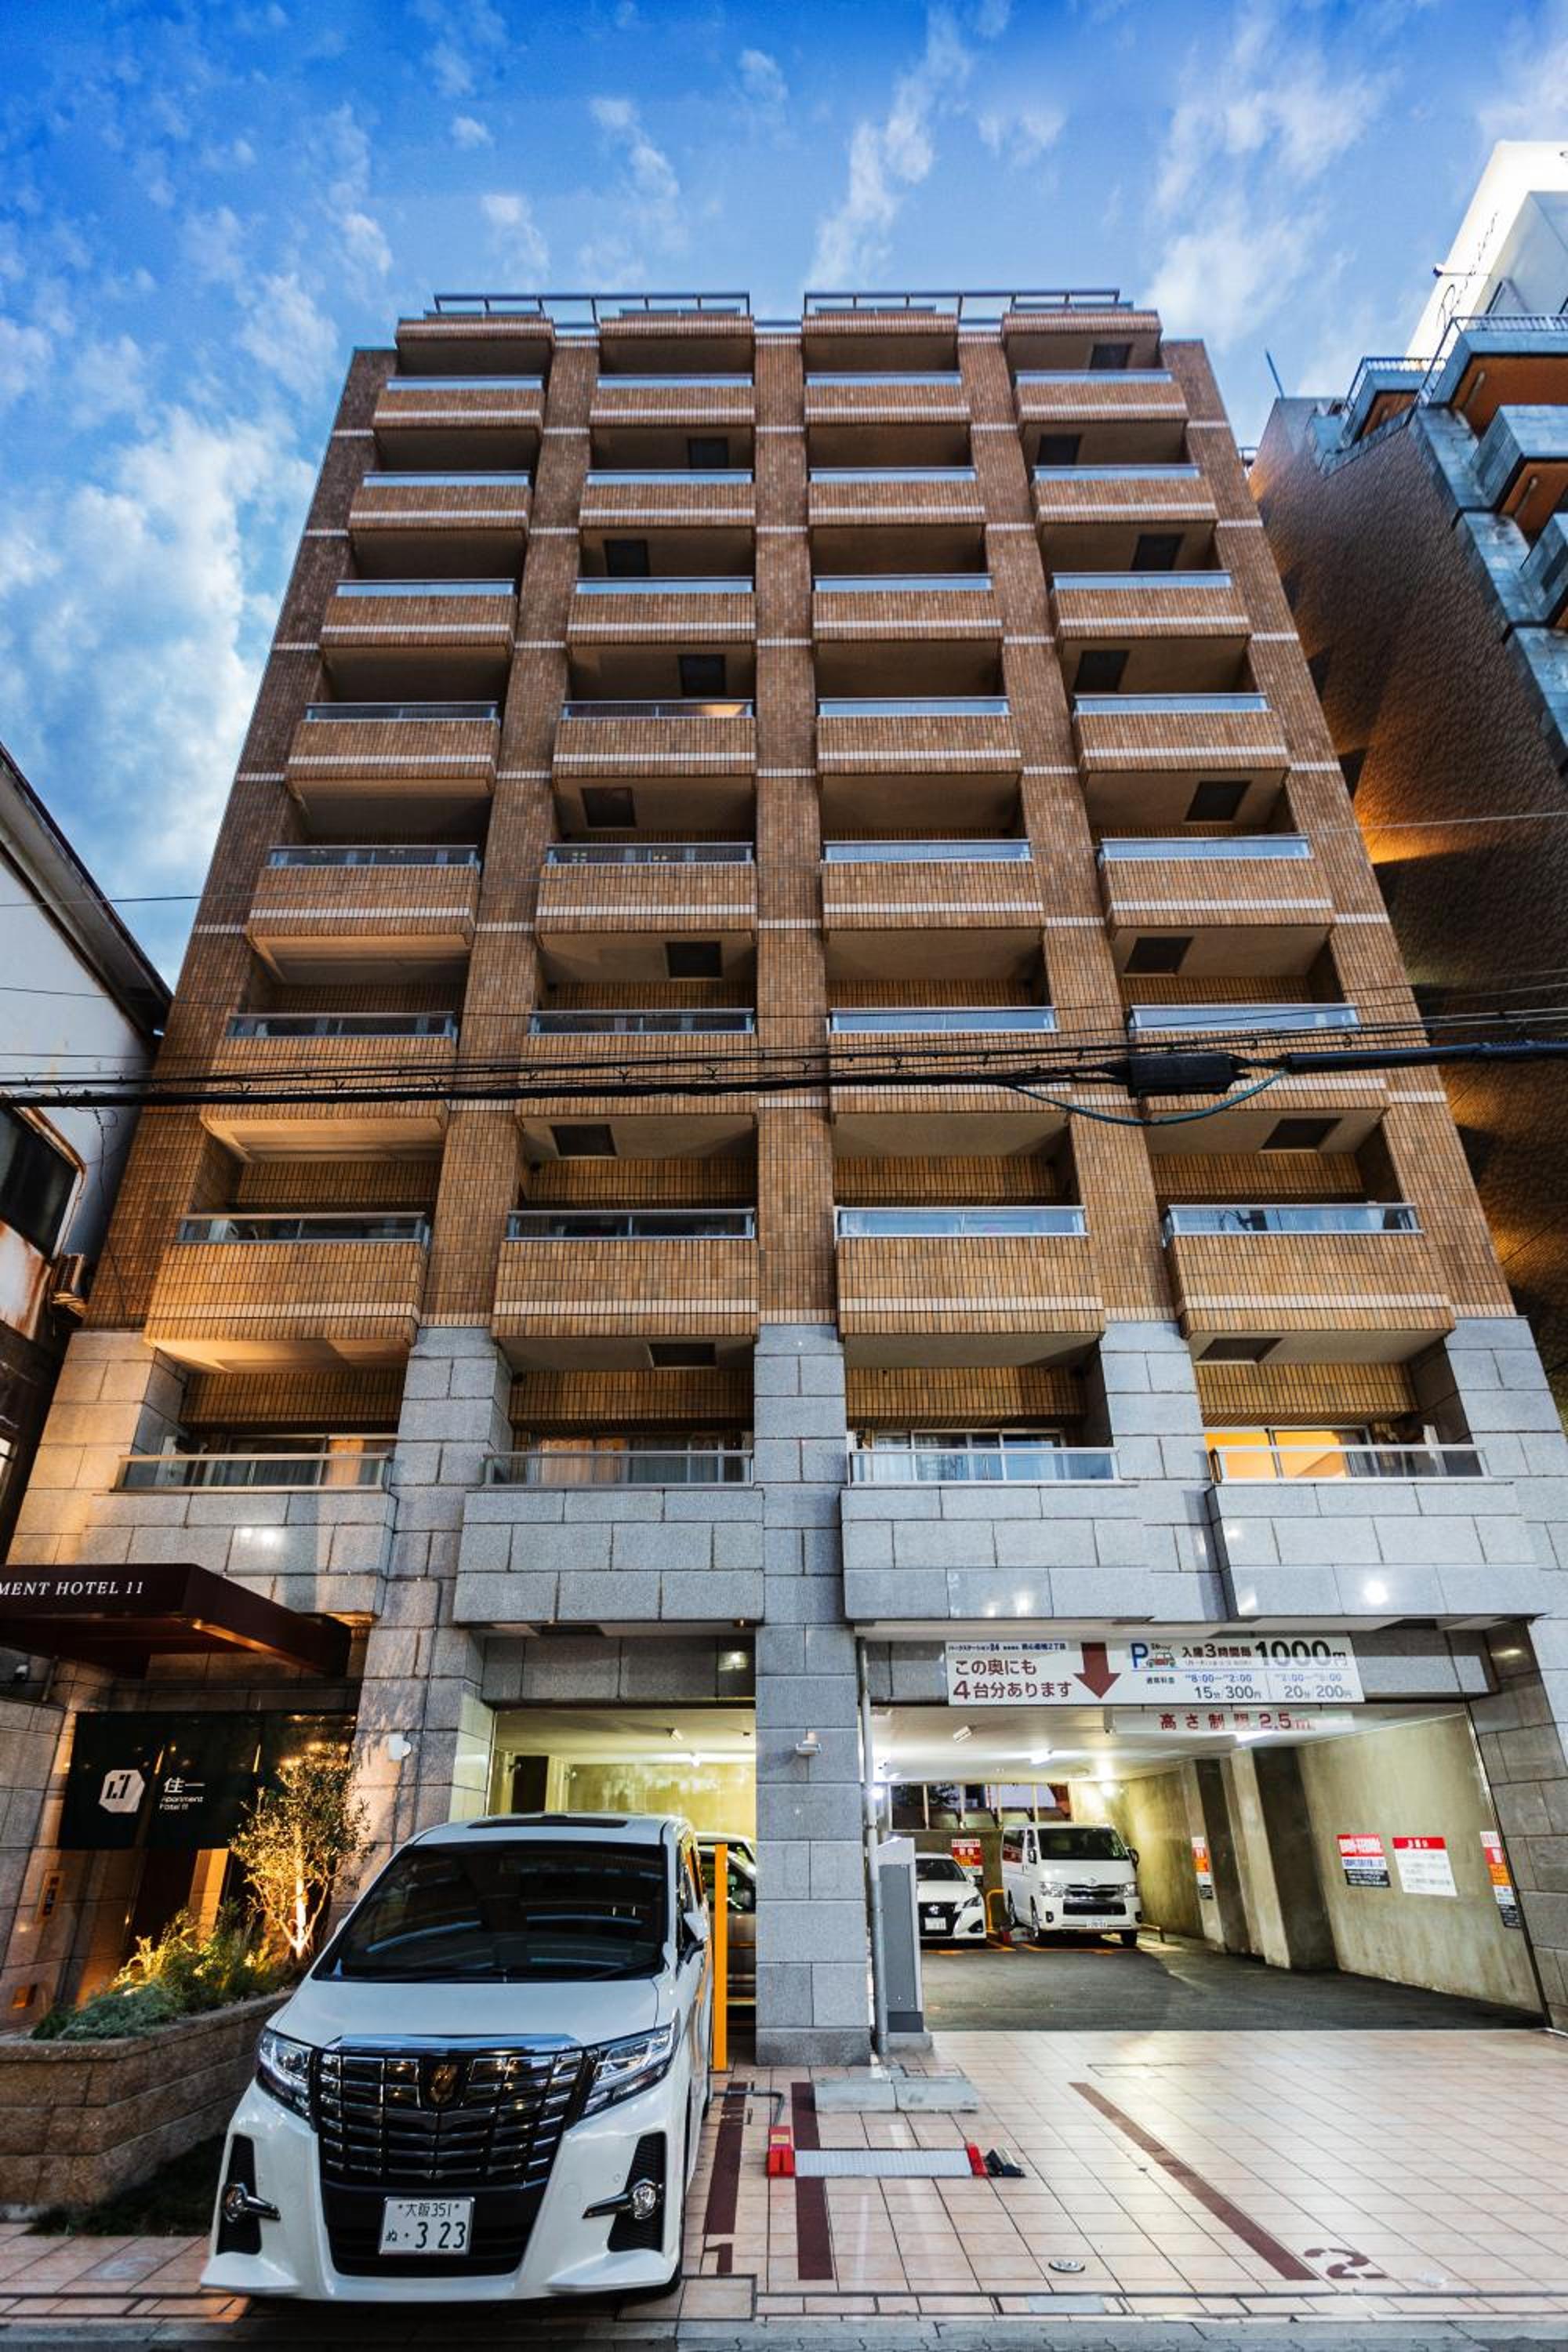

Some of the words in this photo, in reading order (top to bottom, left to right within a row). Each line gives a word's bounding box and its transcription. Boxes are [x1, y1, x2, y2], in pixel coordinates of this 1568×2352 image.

[56, 1581, 118, 1595] HOTEL
[1131, 1642, 1149, 1668] P
[956, 1659, 1036, 1675] この奥にも
[953, 1680, 1072, 1699] 4台分あります
[1304, 2248, 1388, 2279] 2
